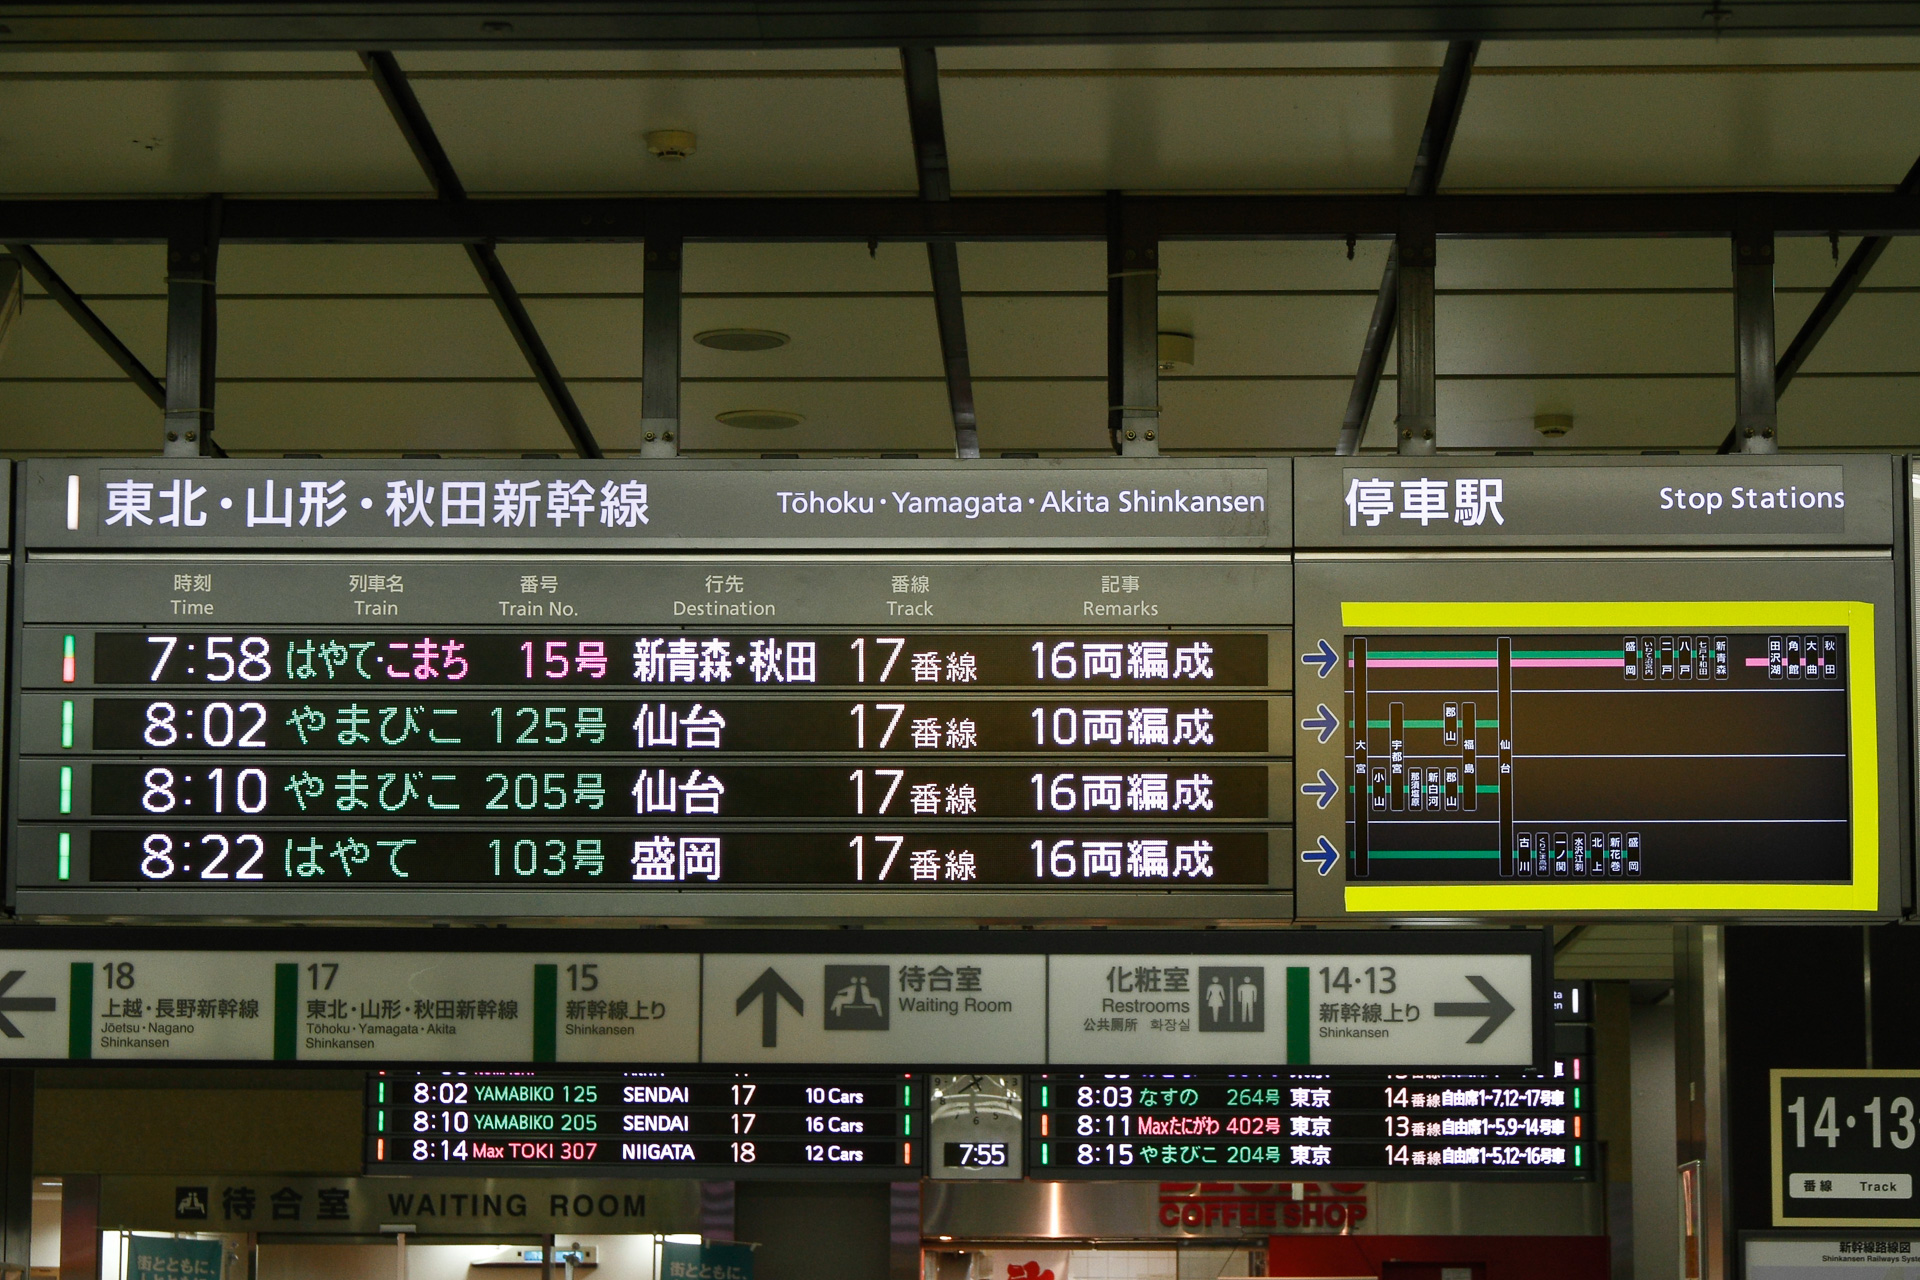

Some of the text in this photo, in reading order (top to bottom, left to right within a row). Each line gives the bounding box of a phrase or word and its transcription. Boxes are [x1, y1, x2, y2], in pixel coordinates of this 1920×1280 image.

[105, 479, 649, 527] 東北・山形・秋田新幹線
[1119, 490, 1264, 512] Shinkansen
[1345, 478, 1504, 526] 停車駅
[1660, 487, 1844, 514] Stop Stations
[174, 574, 211, 592] 時刻
[349, 575, 403, 592] 列車名
[521, 575, 558, 593] 番号
[706, 575, 743, 593] 行先
[892, 575, 929, 593] 番線
[1102, 575, 1139, 593] 記事
[171, 600, 213, 614] Time
[354, 601, 397, 615] Train
[499, 601, 577, 616] Train No.
[674, 601, 775, 615] Destination
[887, 601, 933, 615] Track
[1084, 601, 1158, 615] Remarks
[148, 637, 271, 681] 7:58
[287, 638, 468, 680] はやて・こまち
[521, 642, 607, 678] 15号
[633, 638, 815, 682] 新青森・秋田
[1032, 642, 1213, 678] 16両編成
[1625, 641, 1636, 675] 盛岡
[1661, 641, 1672, 675] 二戸
[1680, 641, 1690, 675] 八戸
[1715, 641, 1727, 675] 新青森
[1770, 641, 1781, 675] 田沢湖
[1788, 641, 1799, 675] 角館
[1806, 641, 1817, 675] 大曲
[1824, 641, 1835, 675] 秋田
[144, 702, 266, 747] 8:02
[286, 703, 461, 745] やまびこ
[491, 708, 606, 743] 125号
[633, 704, 725, 748] 仙台
[1032, 708, 1213, 745] 10両編成
[1445, 706, 1456, 742] 郡山
[1355, 739, 1367, 774] 大宮
[1391, 739, 1403, 774] 宇都宮
[1463, 739, 1475, 774] 福島
[1500, 739, 1511, 774] 仙台
[142, 768, 266, 813] 8:10
[285, 769, 459, 811] やまびこ
[486, 774, 605, 809] 205号
[631, 769, 724, 814] 仙台
[1031, 774, 1213, 811] 16両編成
[1373, 772, 1385, 807] 小山
[1410, 772, 1420, 807] 那須塩原
[1428, 772, 1439, 807] 新白河
[1446, 772, 1457, 807] 郡山
[141, 834, 263, 880] 8:22
[285, 837, 416, 877] はやて
[489, 840, 604, 875] 103号
[631, 836, 720, 880] 盛岡
[1031, 840, 1213, 878] 16両編成
[1519, 837, 1530, 872] 古川
[1555, 840, 1566, 872] 一ノ関
[1574, 837, 1583, 872] 水沢江刺
[1592, 837, 1602, 872] 北上
[1610, 837, 1621, 872] 新花巻
[1628, 837, 1639, 872] 盛岡
[103, 962, 134, 989] 18
[308, 963, 339, 990] 17
[567, 964, 598, 991] 15
[899, 965, 982, 992] 待合室
[1106, 966, 1190, 993] 化粧室
[1319, 967, 1396, 994] 14·13
[102, 998, 259, 1019] 上越・長野新幹線
[307, 999, 518, 1020] 東北・山形・秋田新幹線
[566, 1000, 665, 1020] 新幹線上り
[899, 997, 1011, 1016] Waiting Room
[1103, 998, 1190, 1013] Restrooms
[1319, 1003, 1420, 1023] 新幹線上り
[566, 1024, 634, 1035] Shinkansen
[1150, 1019, 1190, 1031] 화장실
[1319, 1027, 1389, 1038] Shinkansen
[101, 1036, 169, 1048] Shinkansen
[306, 1038, 374, 1048] Shinkansen
[414, 1083, 863, 1105] 8:02 YAMABIKO 125 SENDAI 17 10 Cars
[1077, 1086, 1132, 1107] 8:03
[1140, 1088, 1198, 1106] なすの
[1227, 1089, 1279, 1105] 264号
[1290, 1087, 1331, 1108] 東京
[413, 1111, 863, 1134] 8:10 YAMABIKO 205 SENDAI 17 16 Cars
[1077, 1115, 1129, 1136] 8:11
[1138, 1116, 1219, 1135] Maxたにがわ
[1226, 1117, 1280, 1134] 402号
[1290, 1116, 1331, 1137] 東京
[413, 1140, 863, 1162] 8:14 Max TOKI 307 NIIGATA 18 12 Cars
[960, 1144, 1005, 1165] 7:55
[1077, 1144, 1133, 1165] 8:15
[1140, 1145, 1217, 1163] やまびこ
[1227, 1147, 1280, 1163] 204号
[1290, 1145, 1331, 1166] 東京
[1804, 1180, 1832, 1192] 番線
[1860, 1182, 1896, 1191] Track
[222, 1187, 350, 1221] 待合室
[388, 1193, 646, 1218] WAITING ROOM
[1159, 1203, 1368, 1227] COFFEE SHOP
[1839, 1241, 1911, 1254] 新幹線路線図
